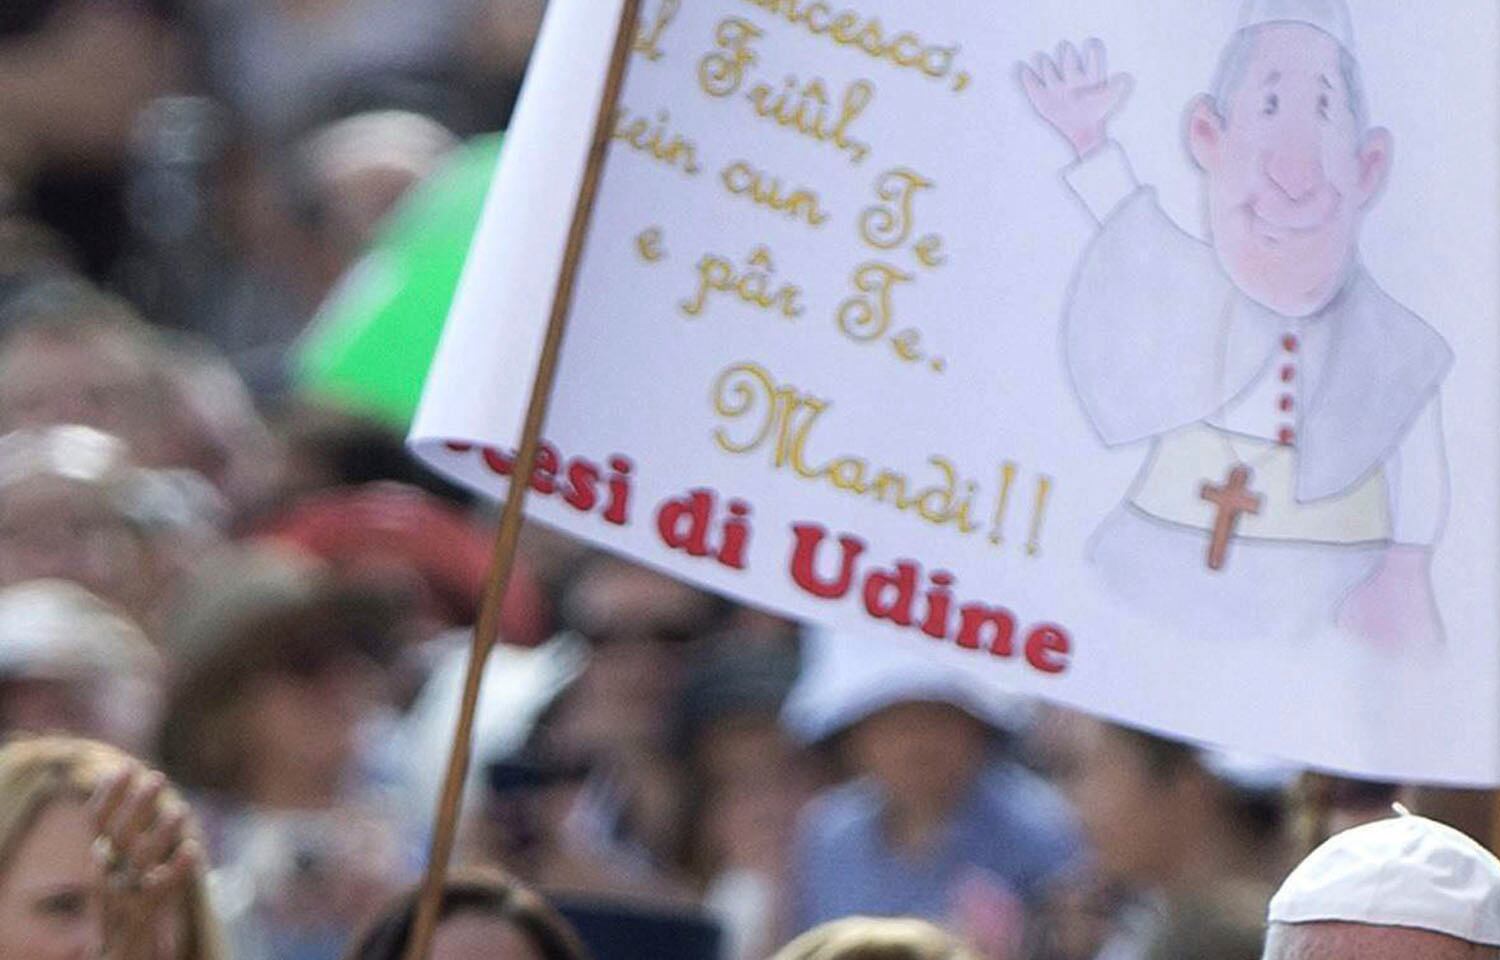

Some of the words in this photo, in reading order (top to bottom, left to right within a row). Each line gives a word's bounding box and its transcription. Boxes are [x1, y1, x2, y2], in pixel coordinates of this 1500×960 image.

[698, 18, 876, 163] Friûl,
[720, 162, 828, 227] cun
[858, 168, 947, 268] Te
[633, 226, 665, 263] e
[681, 244, 803, 318] pâr
[835, 261, 947, 374] Te.
[712, 362, 1053, 557] Mandi!!
[655, 489, 752, 572] di
[788, 521, 1072, 675] Udine
